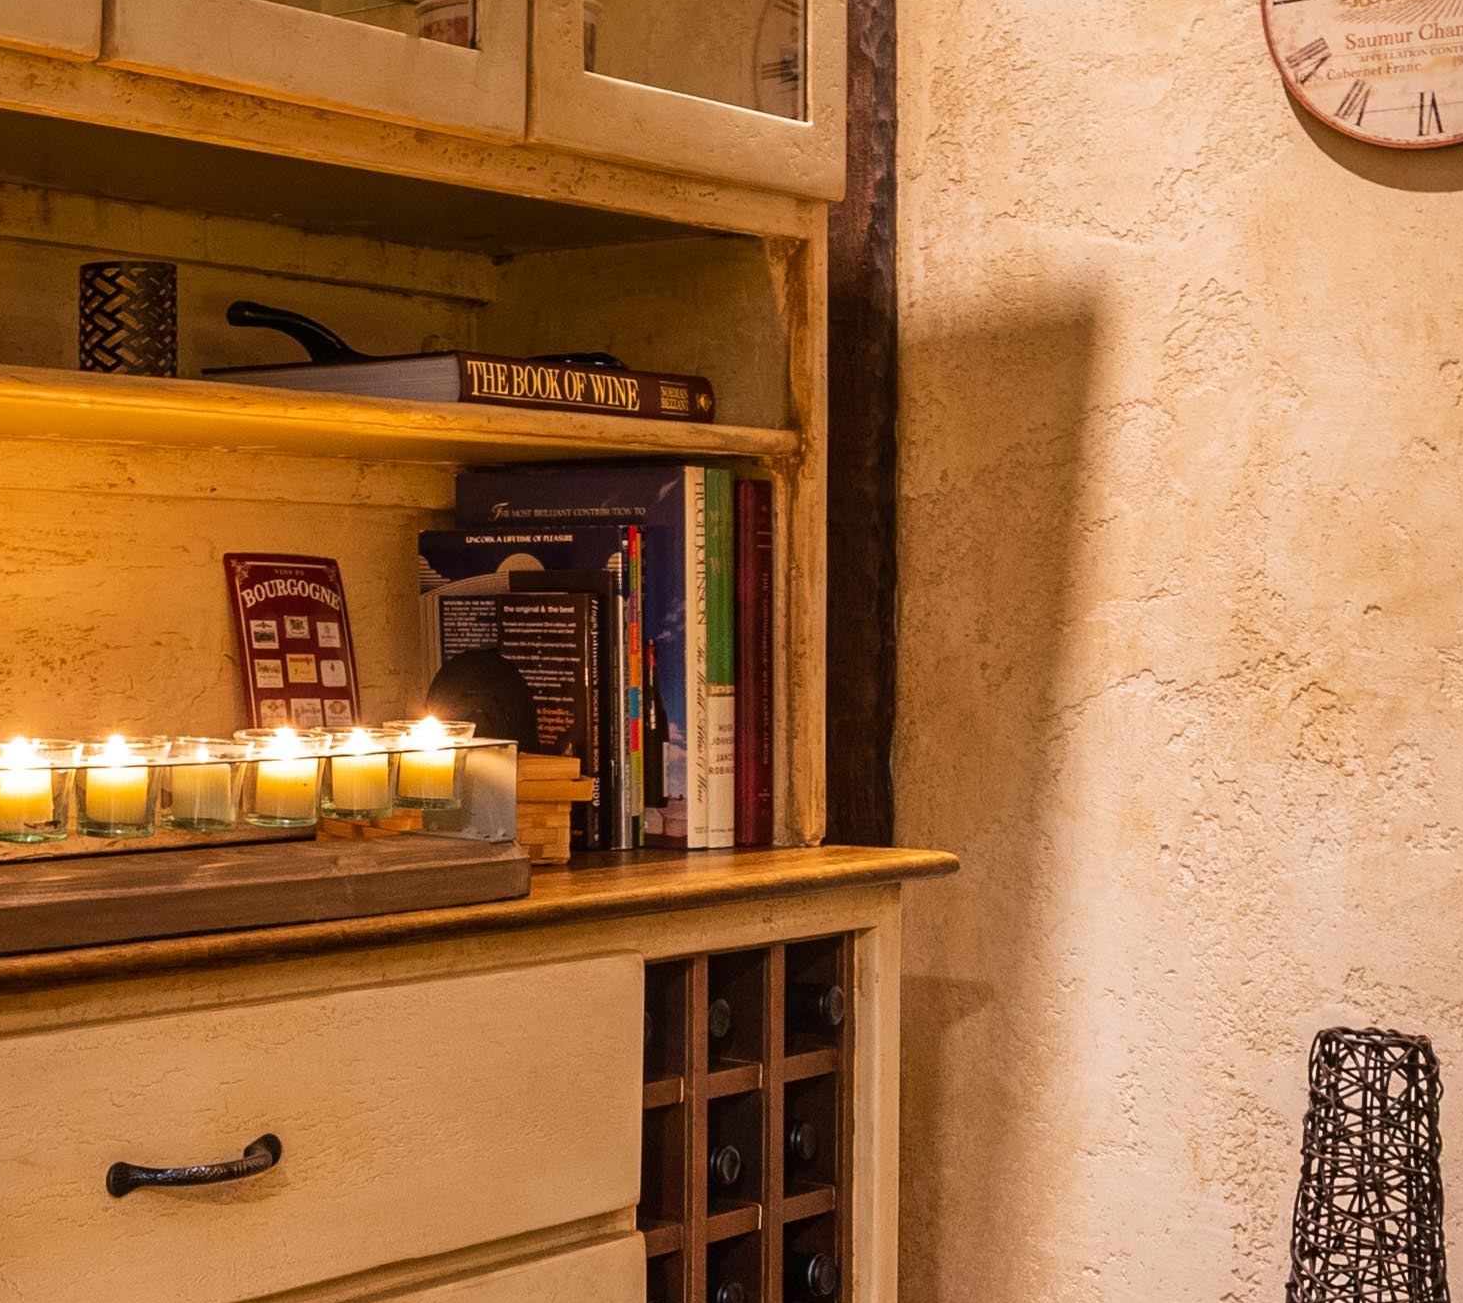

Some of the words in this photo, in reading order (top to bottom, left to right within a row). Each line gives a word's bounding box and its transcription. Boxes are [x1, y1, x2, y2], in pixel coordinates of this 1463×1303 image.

[1345, 31, 1413, 50] Saumur
[1326, 65, 1383, 81] Cabernet
[1385, 61, 1422, 76] Franc
[466, 360, 510, 396] THE
[510, 364, 561, 399] BOOK
[564, 370, 587, 402] OF
[588, 374, 641, 412] WINE
[512, 508, 532, 518] MOST
[534, 508, 572, 518] BRILLIANT
[574, 506, 632, 518] CONTRIBUTION
[633, 506, 647, 516] TO
[466, 536, 496, 544] UNCORK
[497, 535, 503, 544] A
[503, 535, 531, 544] LIFETIME
[532, 535, 542, 543] OF
[542, 534, 573, 543] PLEASURE
[241, 579, 340, 611] BOURGOGNE
[516, 605, 539, 614] original
[592, 689, 600, 722] POCKET
[592, 724, 600, 747] WINE
[592, 748, 600, 773] BOOK
[592, 776, 601, 808] 2009
